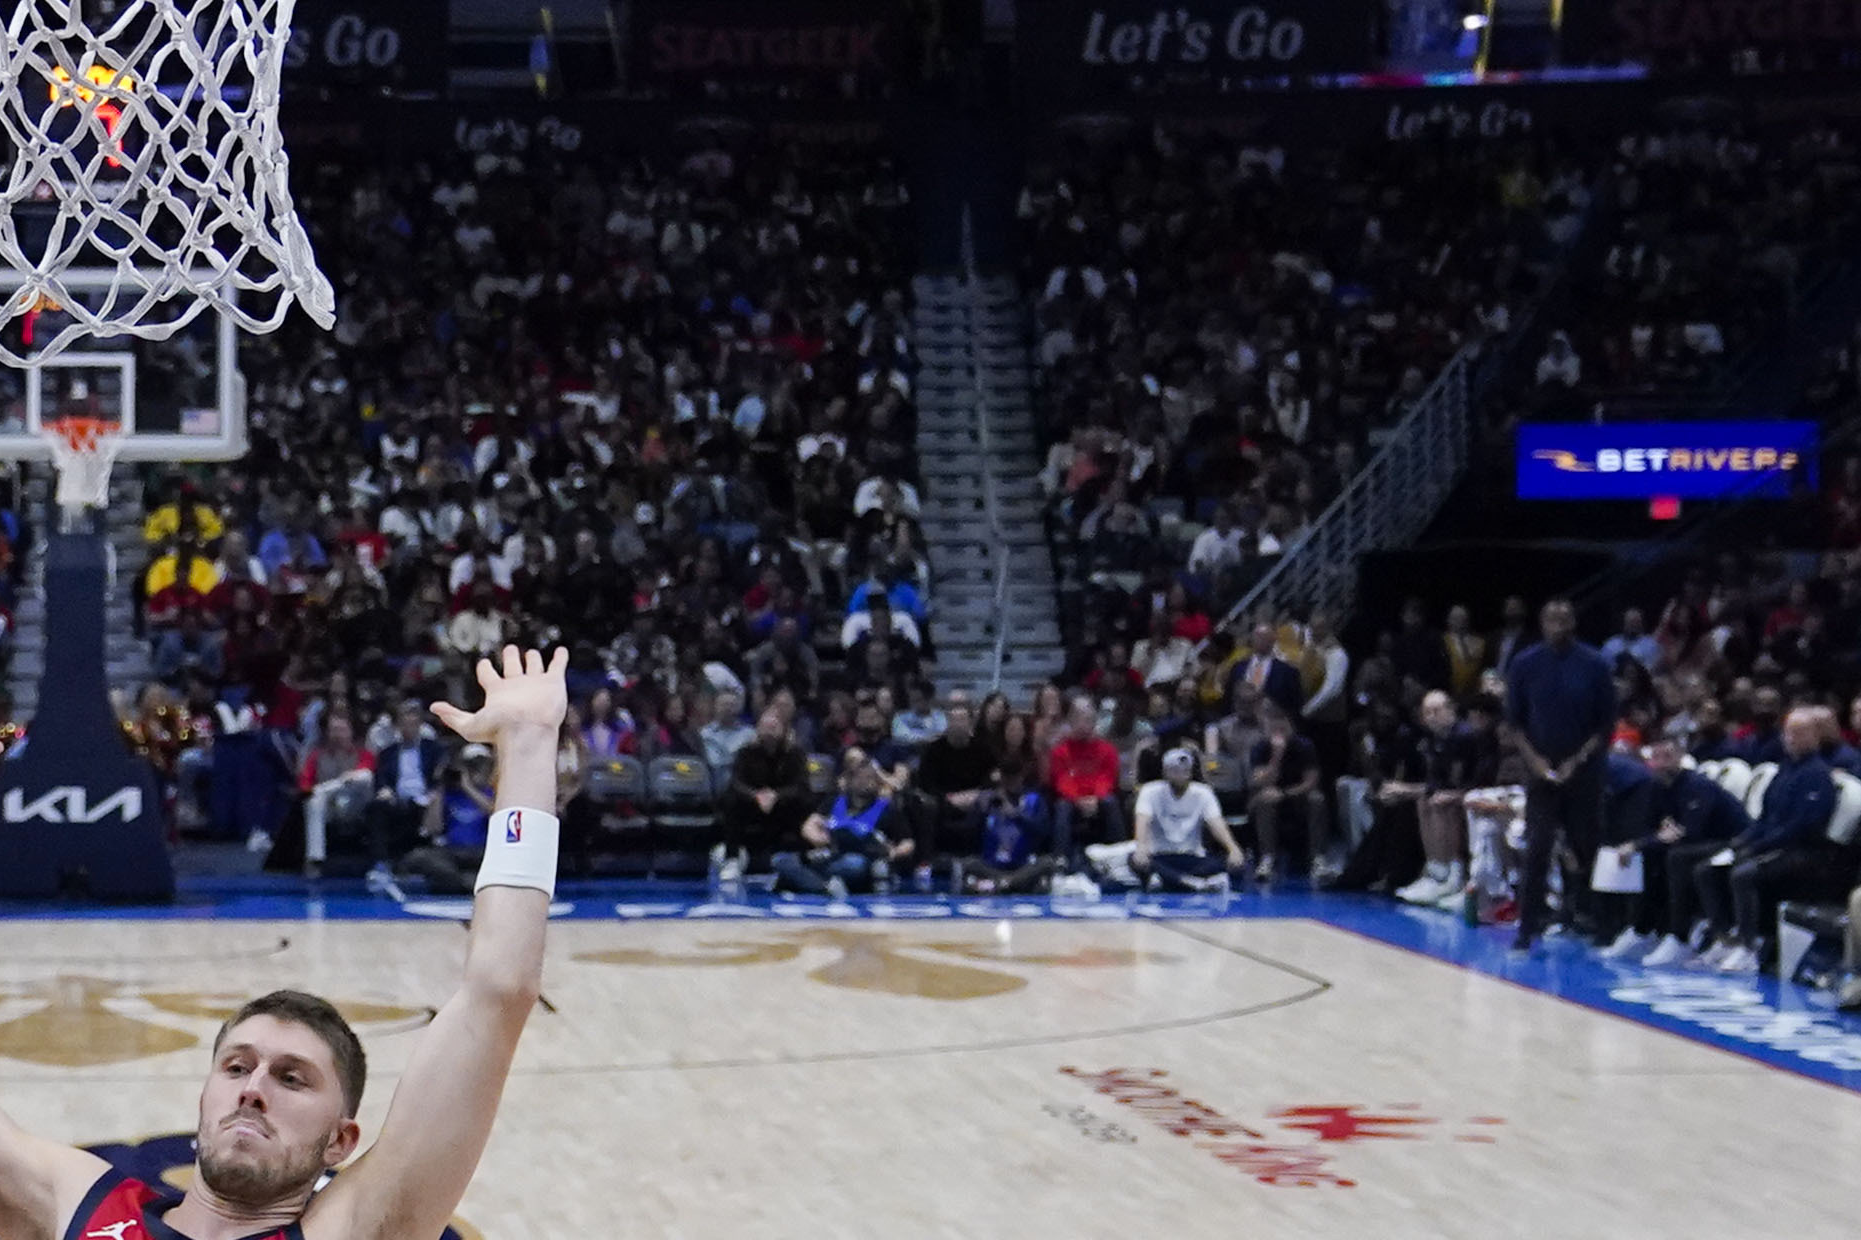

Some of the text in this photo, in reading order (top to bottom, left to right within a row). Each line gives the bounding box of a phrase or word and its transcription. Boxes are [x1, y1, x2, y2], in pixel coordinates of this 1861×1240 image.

[324, 14, 400, 67] Go
[1081, 7, 1304, 65] Let's Go
[2, 786, 143, 824] KIA
